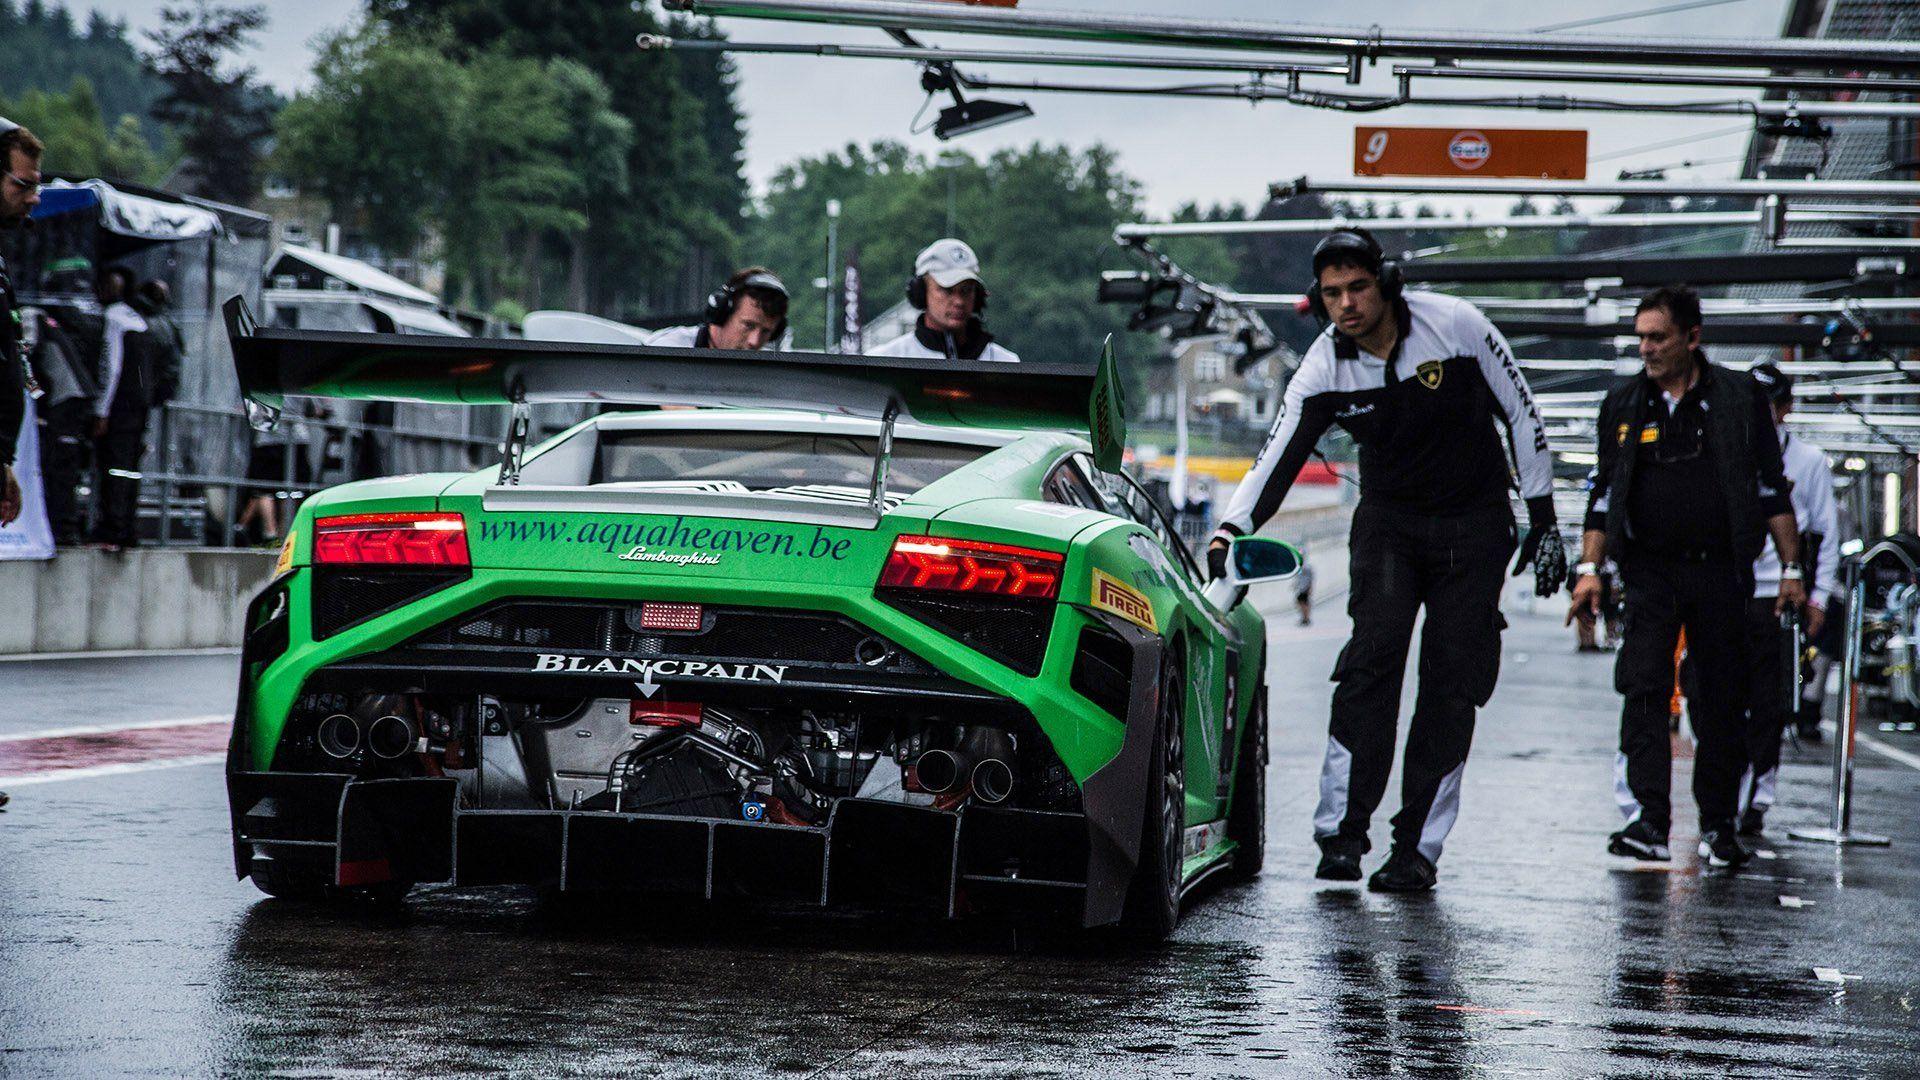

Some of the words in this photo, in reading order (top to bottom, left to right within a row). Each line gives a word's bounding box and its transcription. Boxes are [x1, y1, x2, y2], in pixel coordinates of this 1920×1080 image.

[1363, 130, 1390, 164] 9
[1485, 332, 1548, 453] BLANCPAIN
[479, 516, 852, 560] www.aquaheaven.be
[618, 546, 722, 567] Lamborghini
[1099, 578, 1152, 625] PIRELLI
[531, 653, 789, 684] BLANCPAIN
